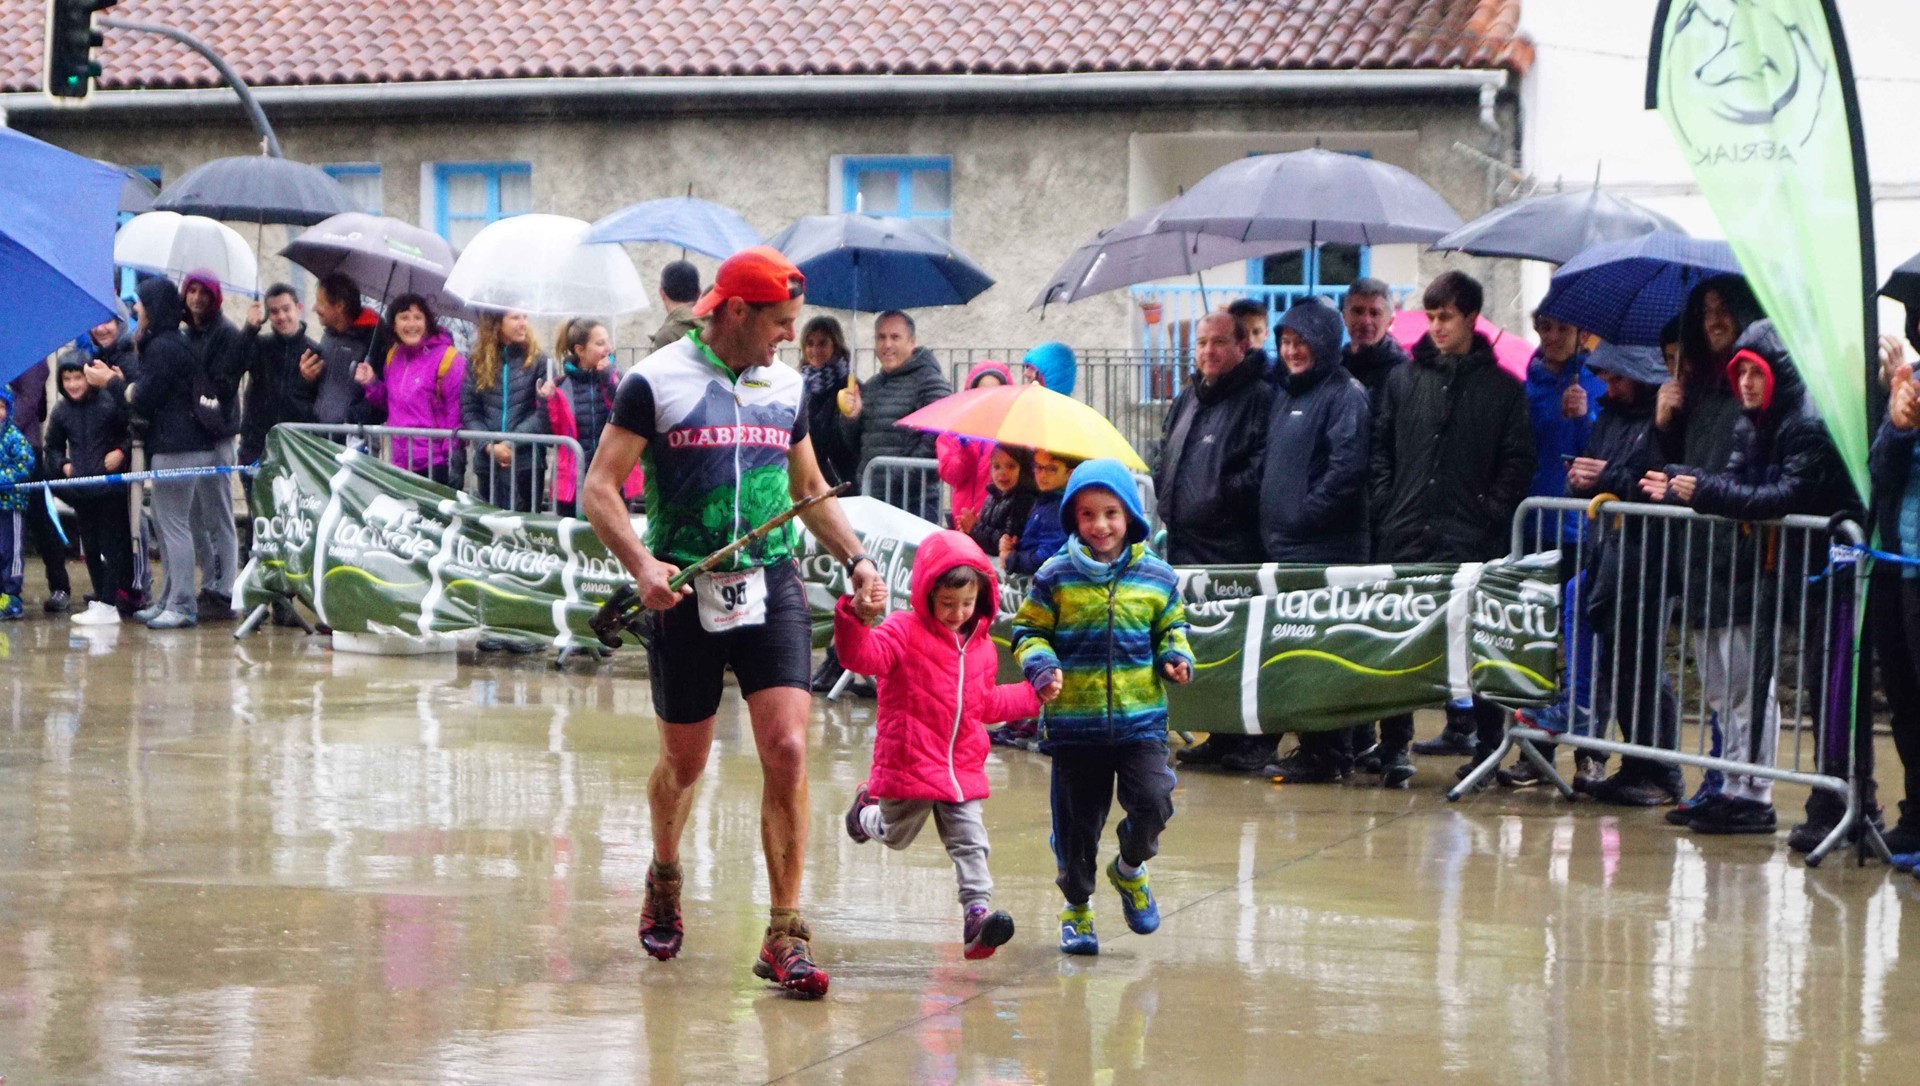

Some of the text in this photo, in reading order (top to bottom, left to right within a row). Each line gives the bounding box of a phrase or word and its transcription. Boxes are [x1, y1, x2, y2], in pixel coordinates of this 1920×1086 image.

[457, 535, 560, 574] lacturale
[581, 582, 613, 594] esnea
[1214, 579, 1252, 598] leche
[1275, 584, 1437, 622] lacturale
[1271, 623, 1317, 638] esnea
[1473, 630, 1516, 651] esnea
